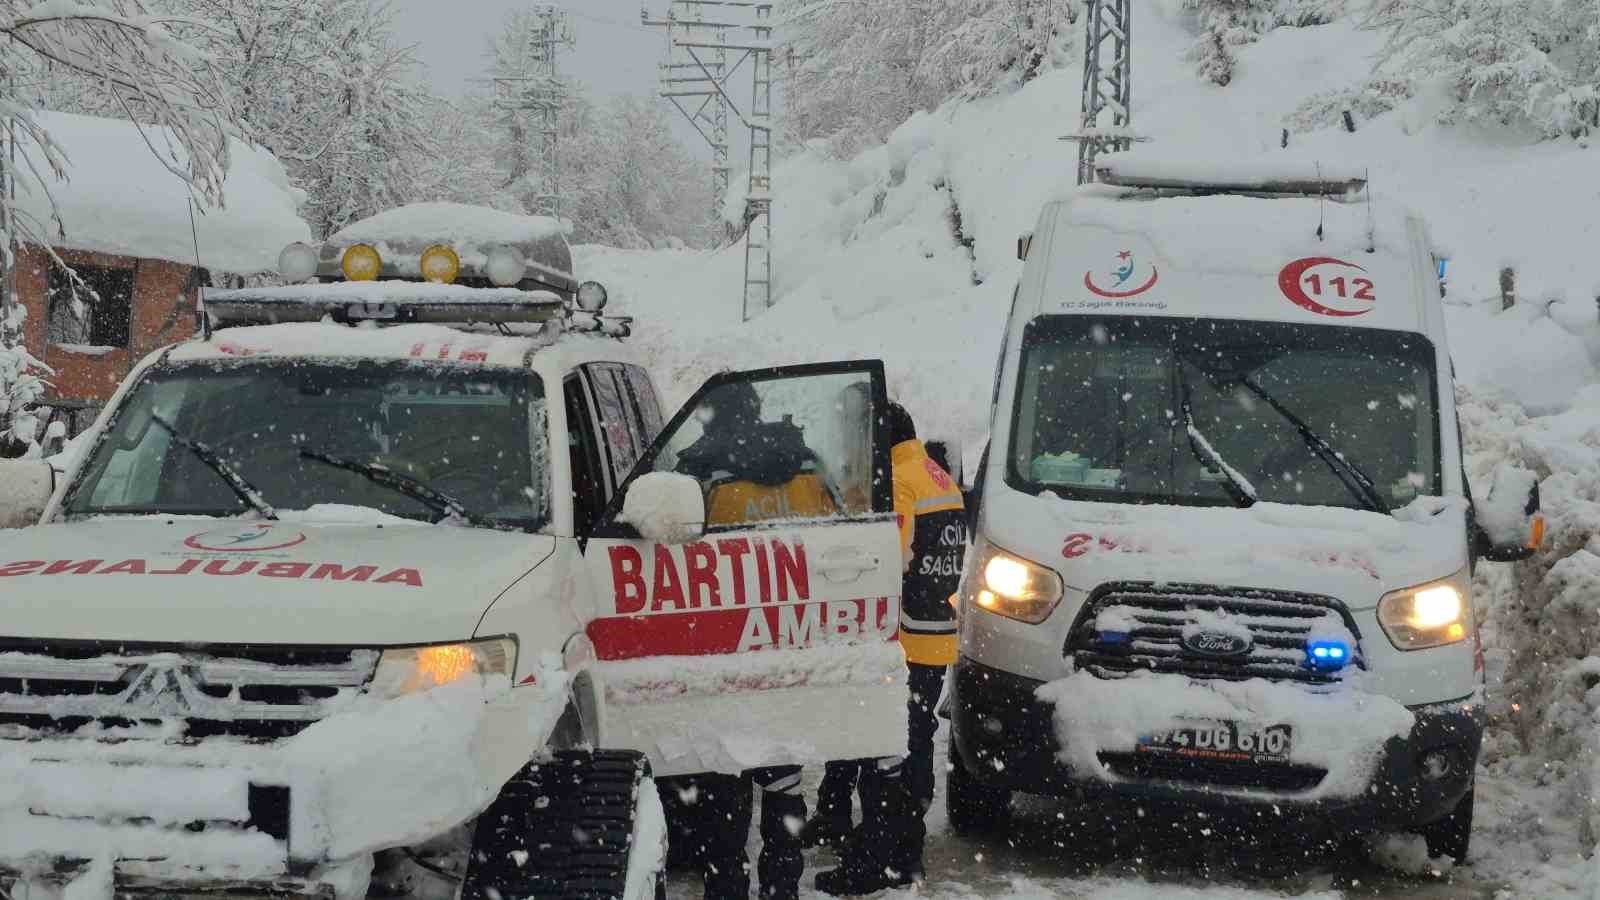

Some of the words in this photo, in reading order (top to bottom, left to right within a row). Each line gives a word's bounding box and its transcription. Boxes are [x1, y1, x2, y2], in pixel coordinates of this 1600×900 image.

[1304, 274, 1376, 302] 112
[607, 536, 810, 614] BARTIN
[1198, 631, 1234, 651] Ford
[1195, 727, 1231, 750] DG
